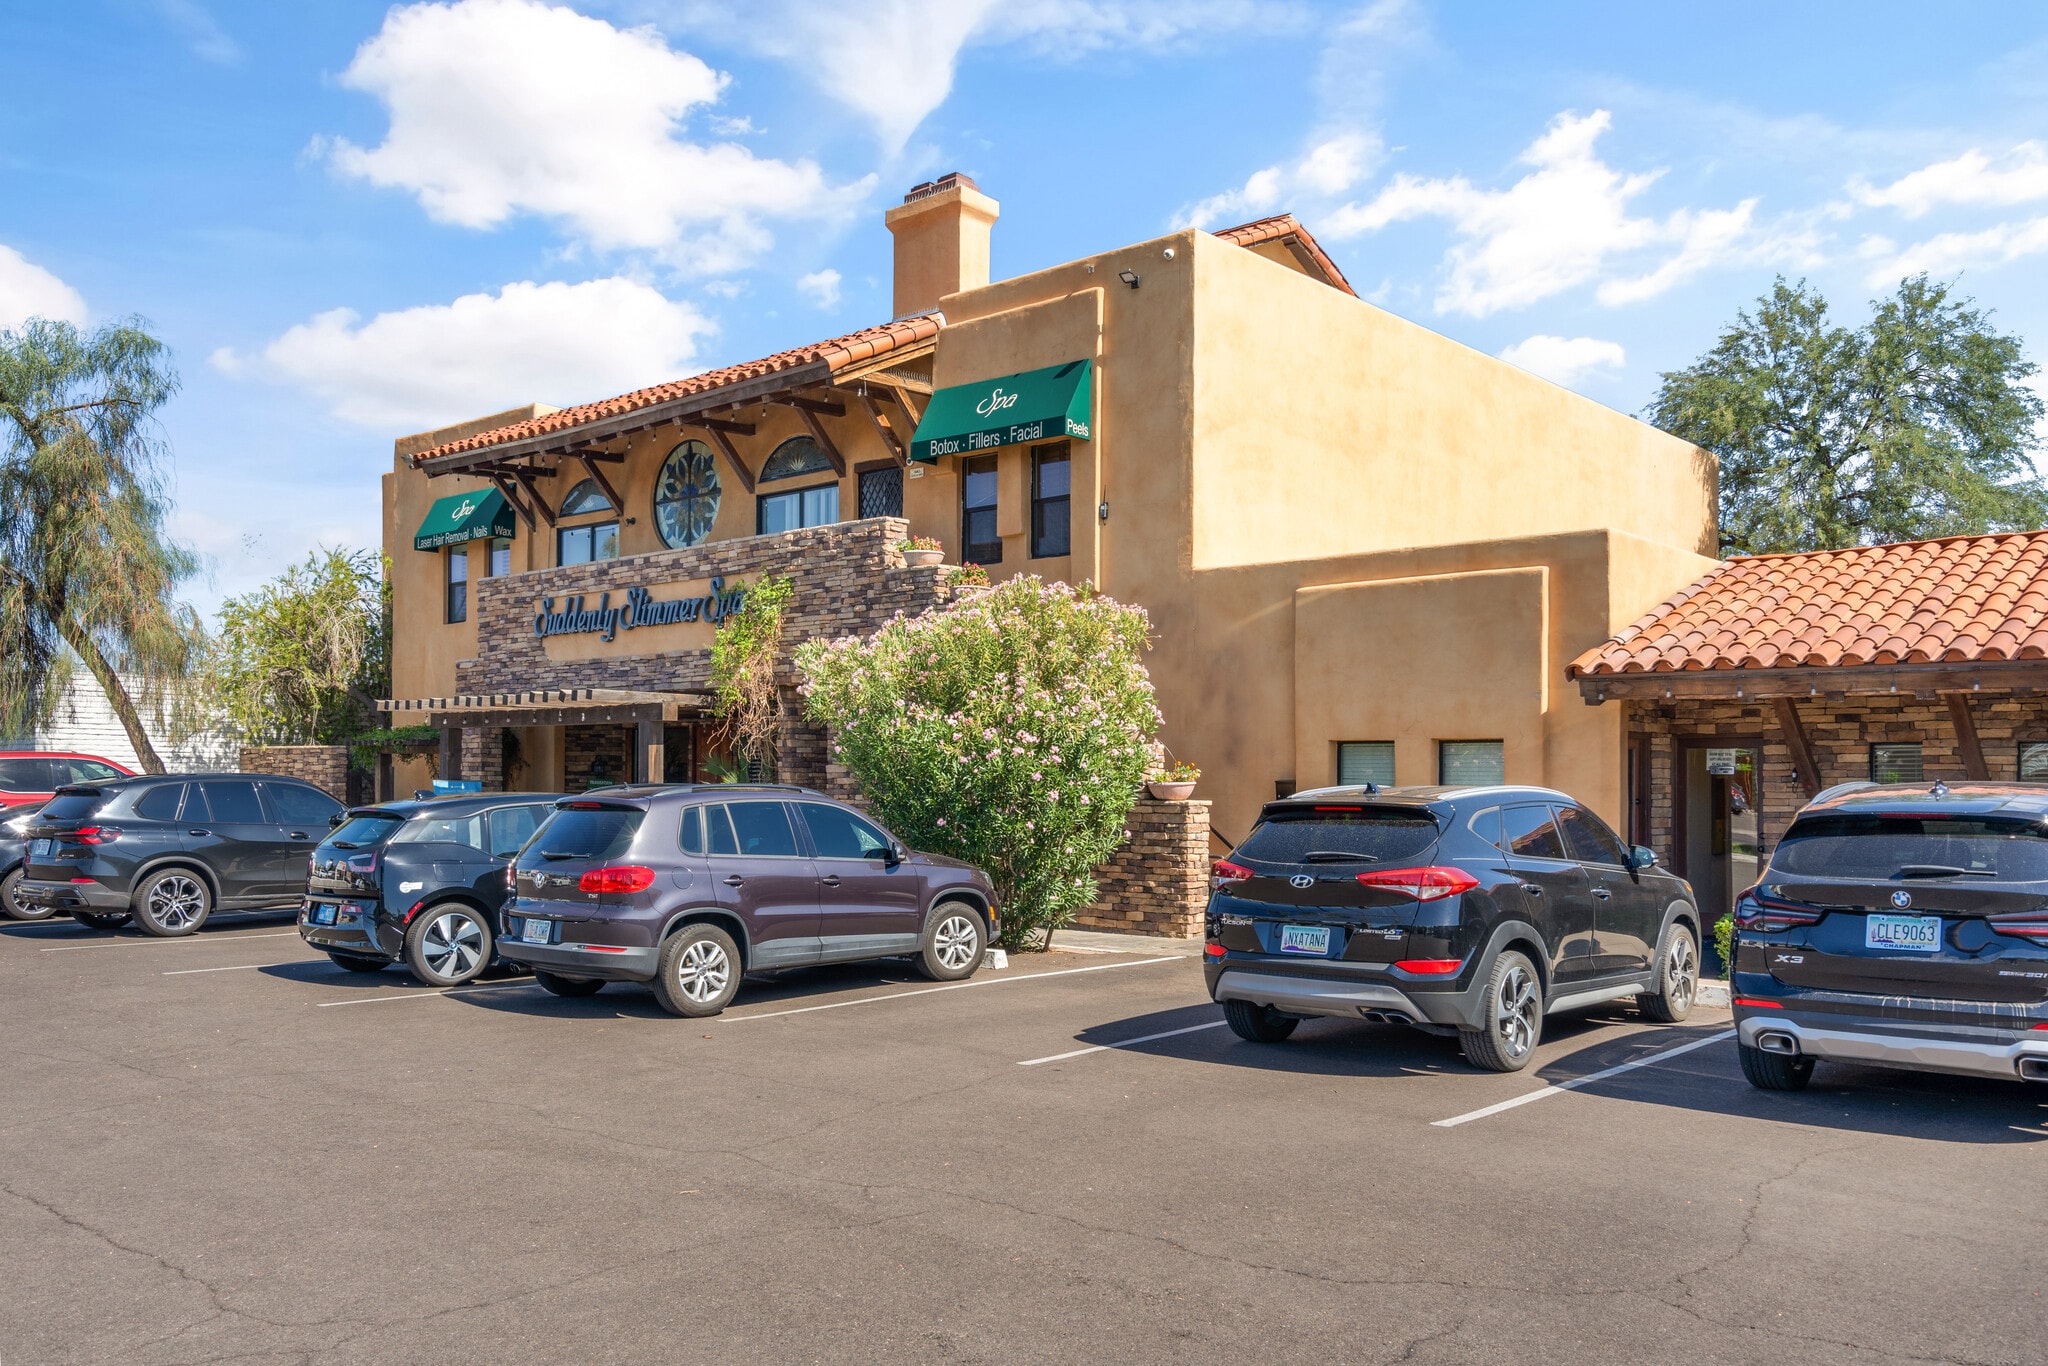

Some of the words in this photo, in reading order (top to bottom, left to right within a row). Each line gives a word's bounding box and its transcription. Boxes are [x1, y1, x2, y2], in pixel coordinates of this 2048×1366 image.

[976, 388, 1018, 418] Spa
[1067, 418, 1089, 437] Peels
[930, 439, 960, 456] Botox
[968, 432, 1000, 450] Fillers
[1010, 421, 1043, 443] Facial
[452, 499, 475, 521] Spa
[417, 535, 432, 549] Laser
[432, 533, 445, 547] Hair
[445, 528, 470, 544] Removal
[473, 525, 488, 539] Nails
[494, 524, 512, 537] Wax
[534, 592, 619, 642] Suddenly
[618, 586, 702, 630] Slimmer
[701, 576, 747, 628] Spa
[1288, 931, 1326, 947] NXA7ANA
[1877, 923, 1935, 941] CLE9063
[1774, 954, 1804, 964] X3
